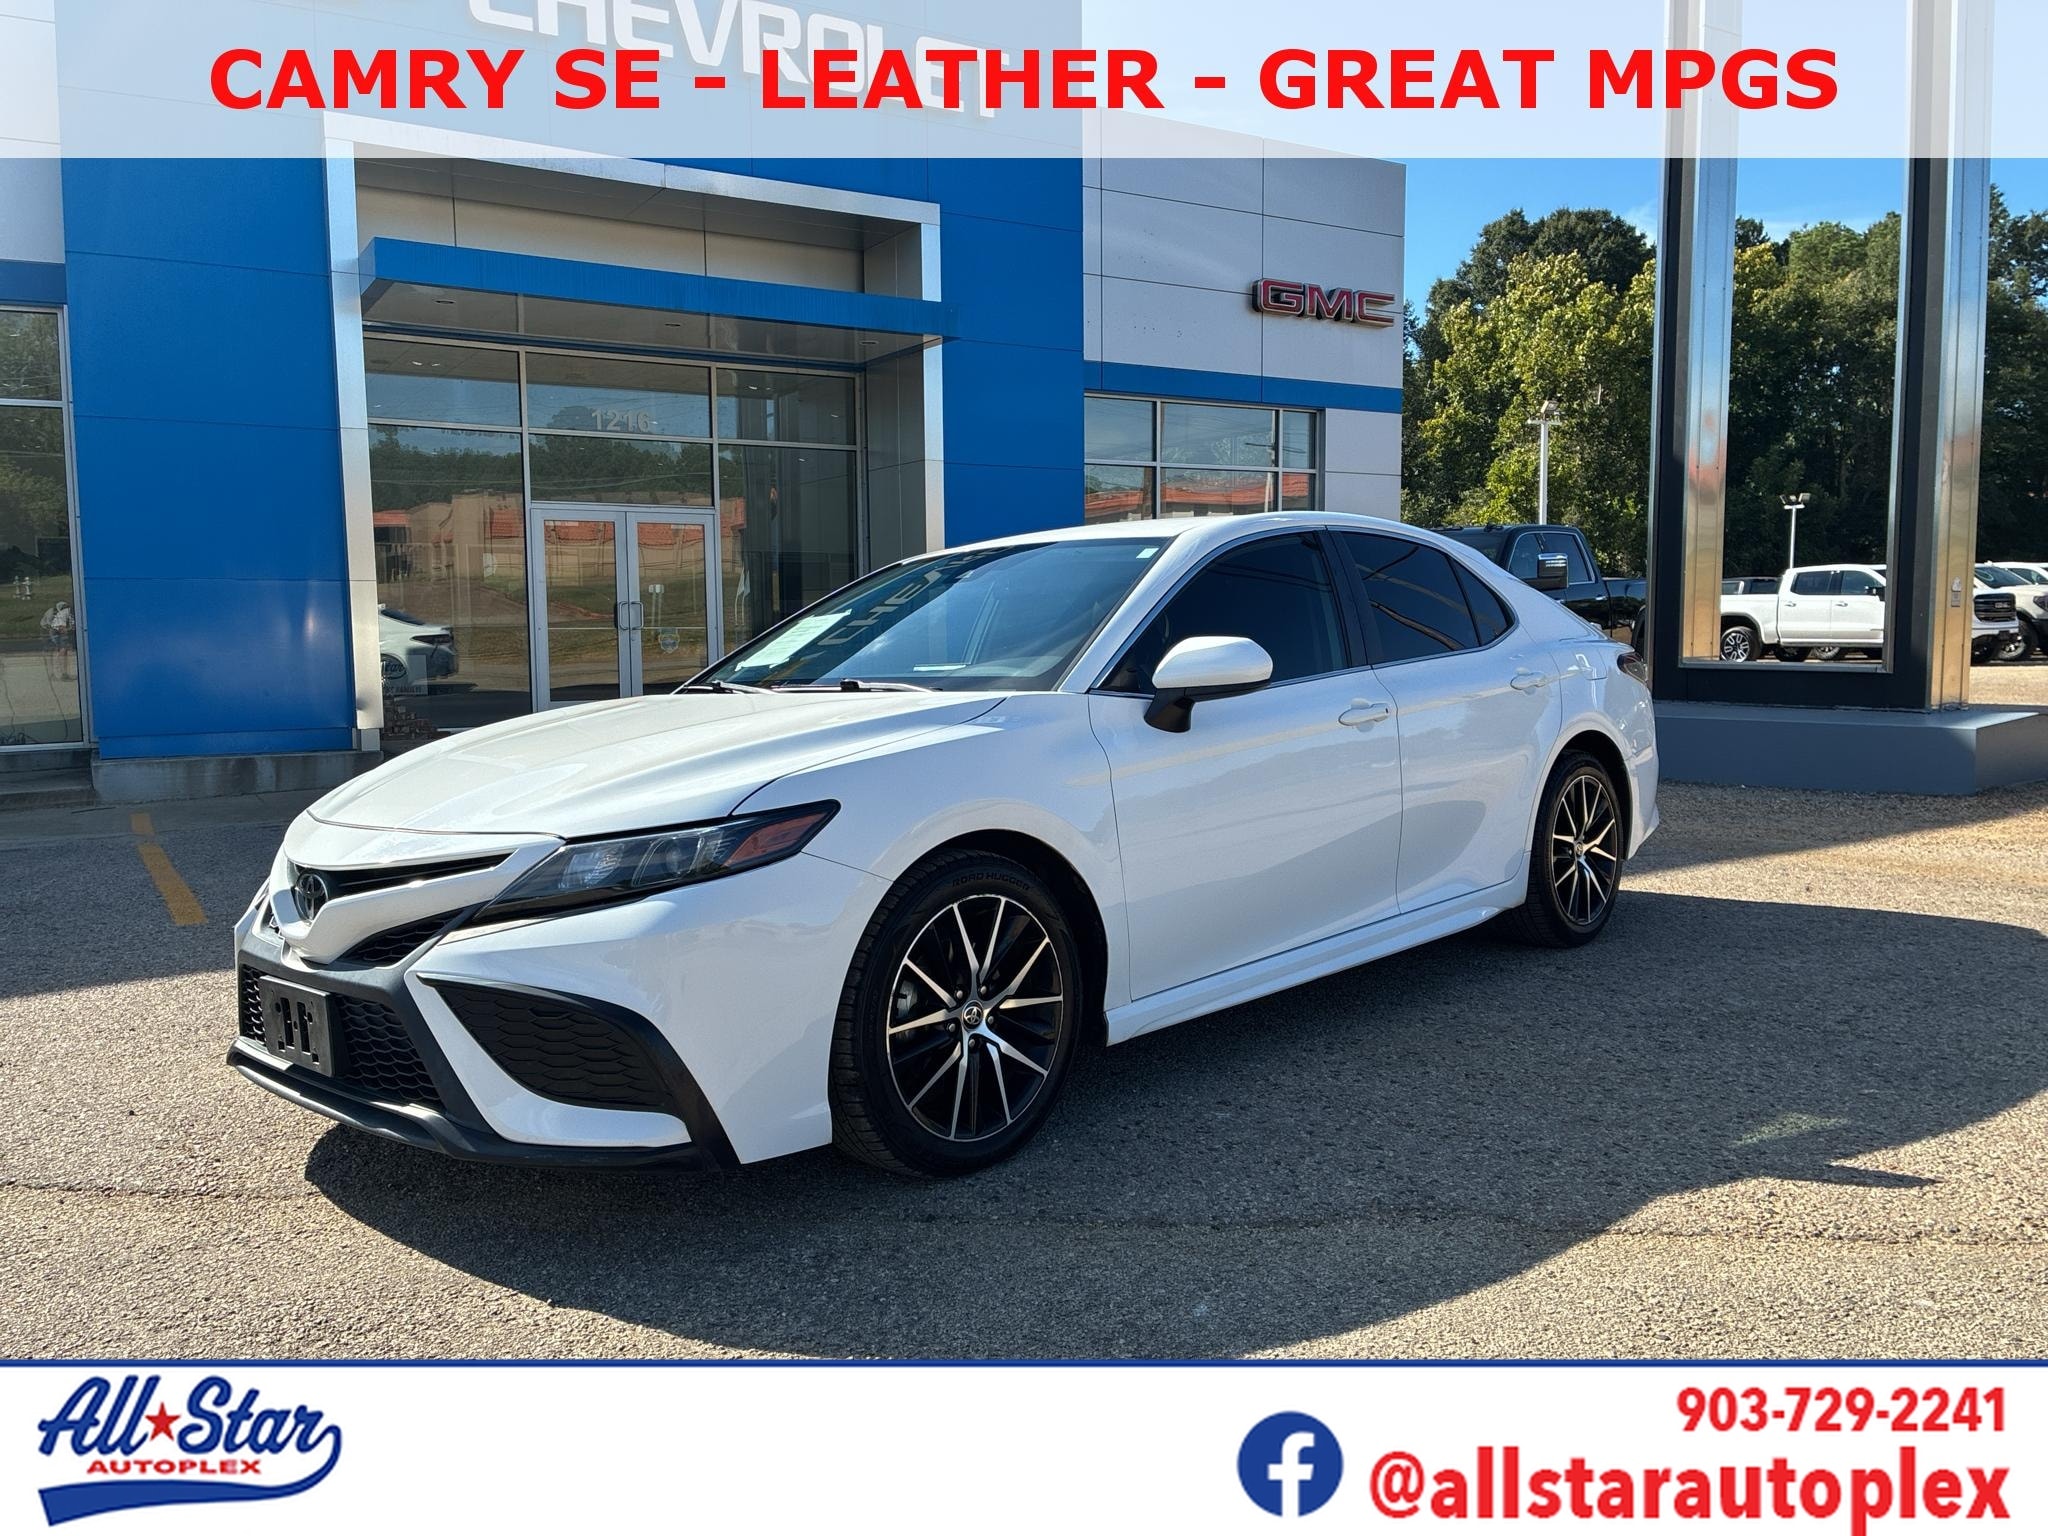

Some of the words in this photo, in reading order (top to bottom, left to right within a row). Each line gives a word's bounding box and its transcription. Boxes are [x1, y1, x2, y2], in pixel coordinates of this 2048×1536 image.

[469, 0, 1010, 118] EVROLET
[1252, 278, 1395, 327] GMC
[591, 408, 650, 433] 1216
